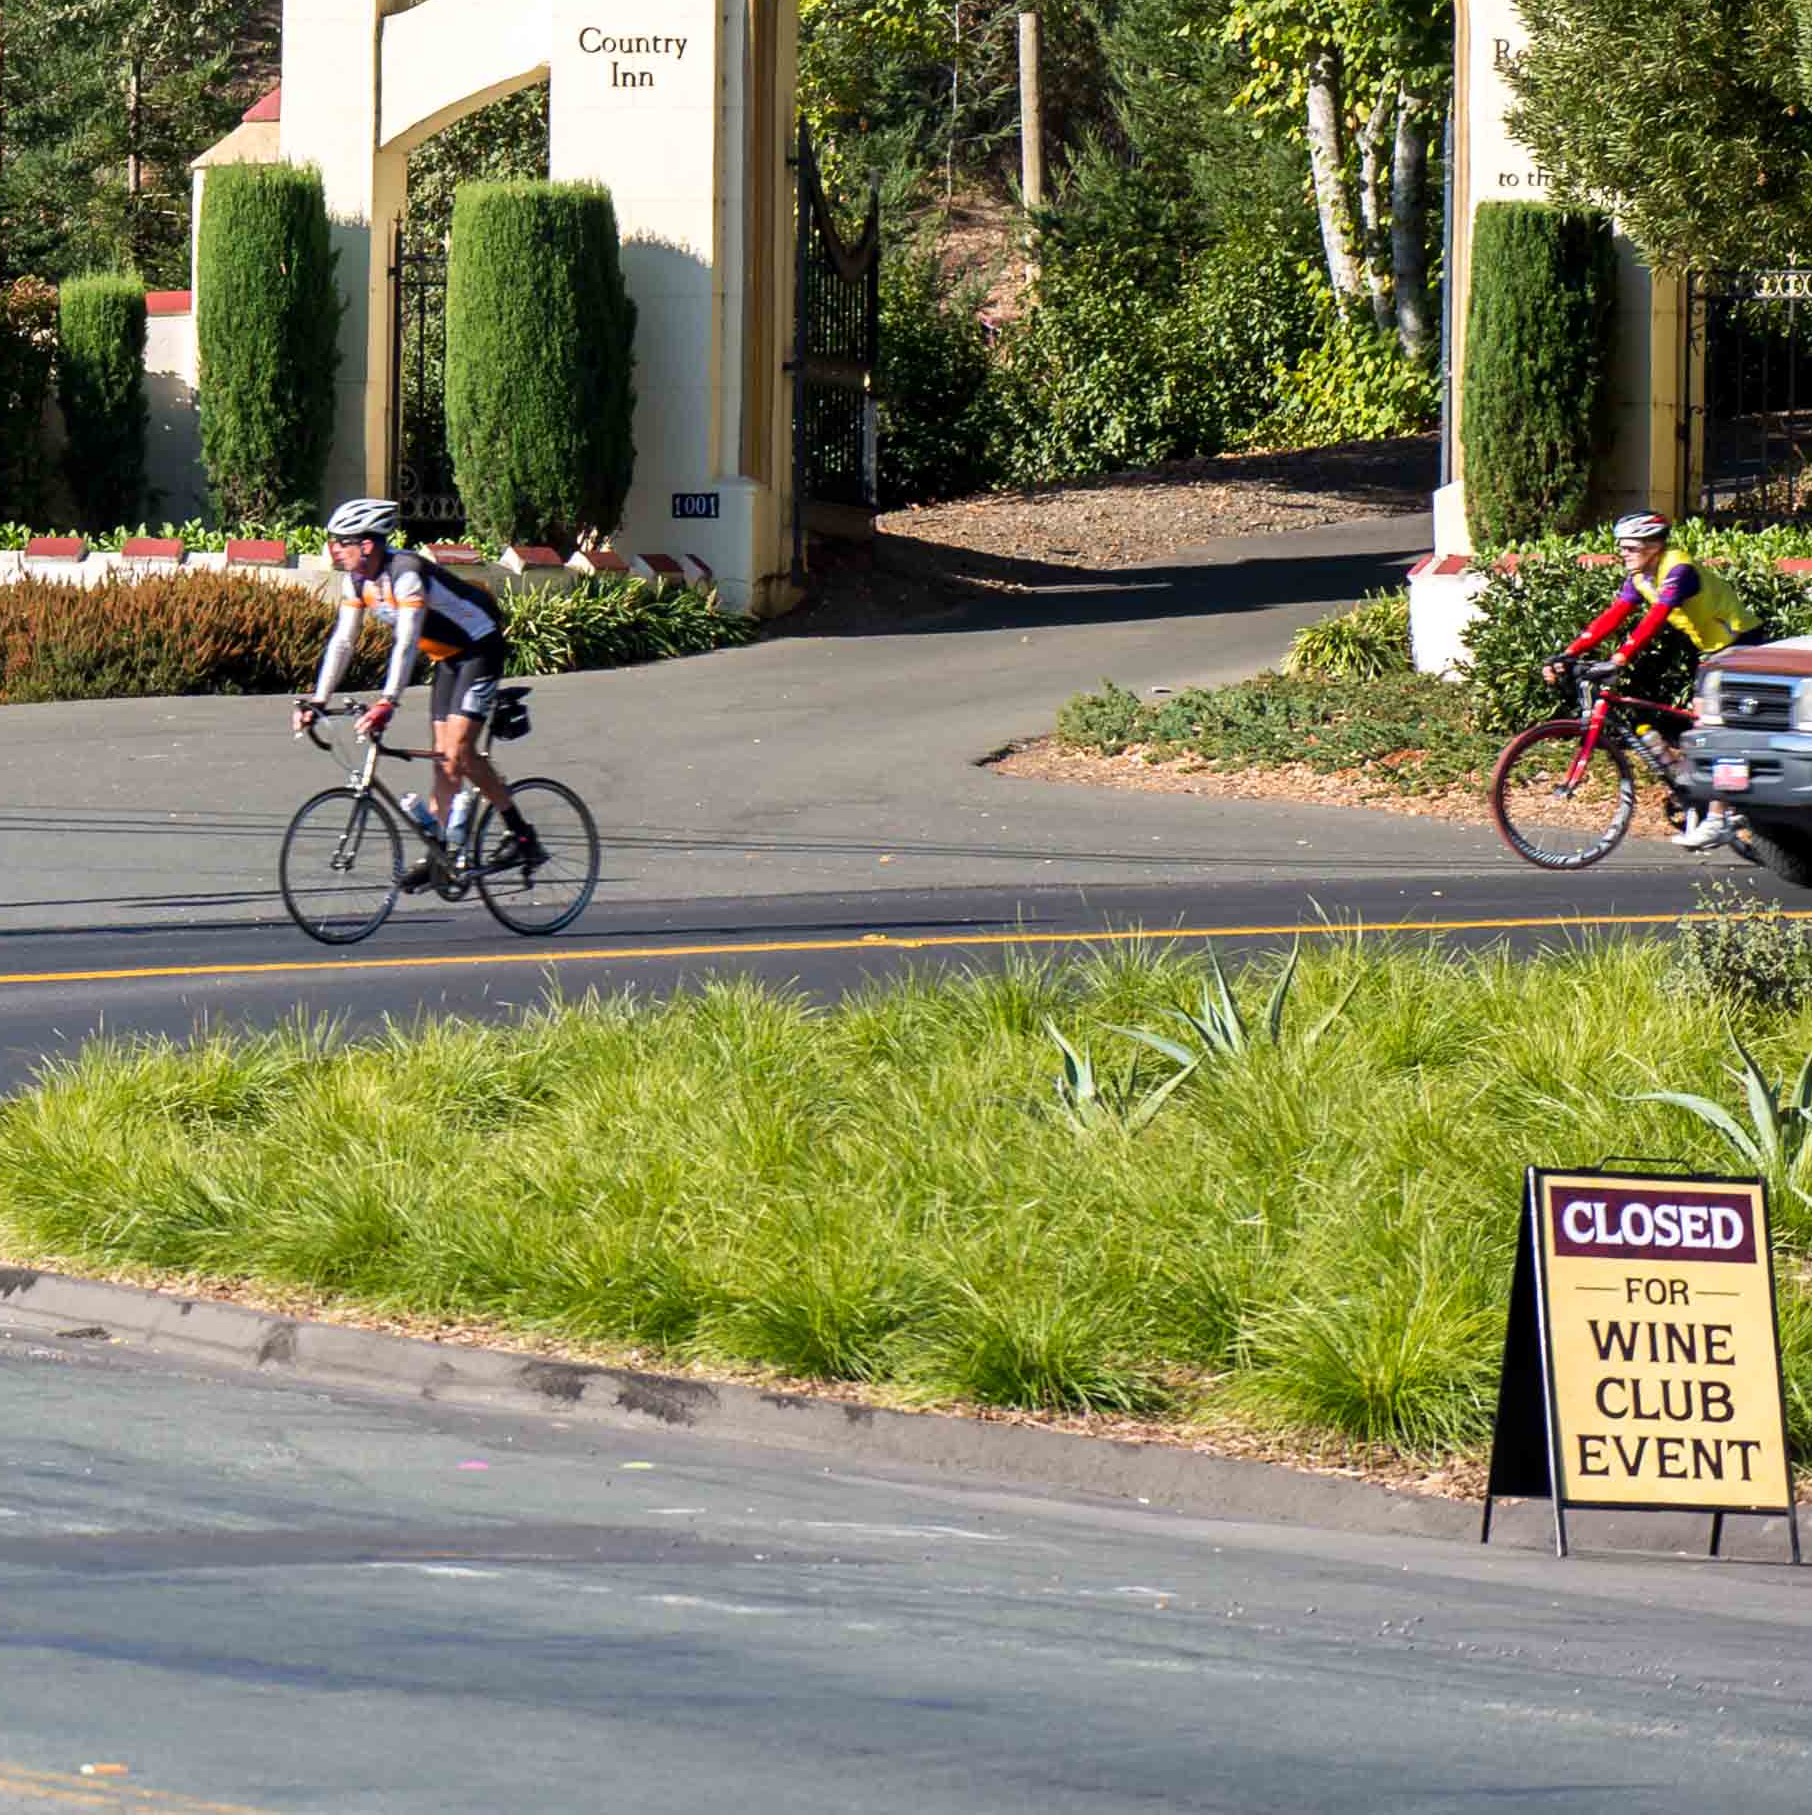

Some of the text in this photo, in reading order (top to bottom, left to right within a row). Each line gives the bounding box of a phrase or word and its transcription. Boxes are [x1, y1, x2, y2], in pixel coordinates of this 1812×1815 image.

[578, 26, 688, 60] Country
[611, 61, 655, 88] Inn
[1497, 166, 1550, 187] to th
[674, 496, 718, 516] 1001
[1562, 1200, 1744, 1250] CLOSED
[1625, 1277, 1690, 1305] FOR
[1589, 1320, 1736, 1366] WINE
[1595, 1377, 1735, 1423] CLUB
[1577, 1434, 1761, 1482] EVENT
